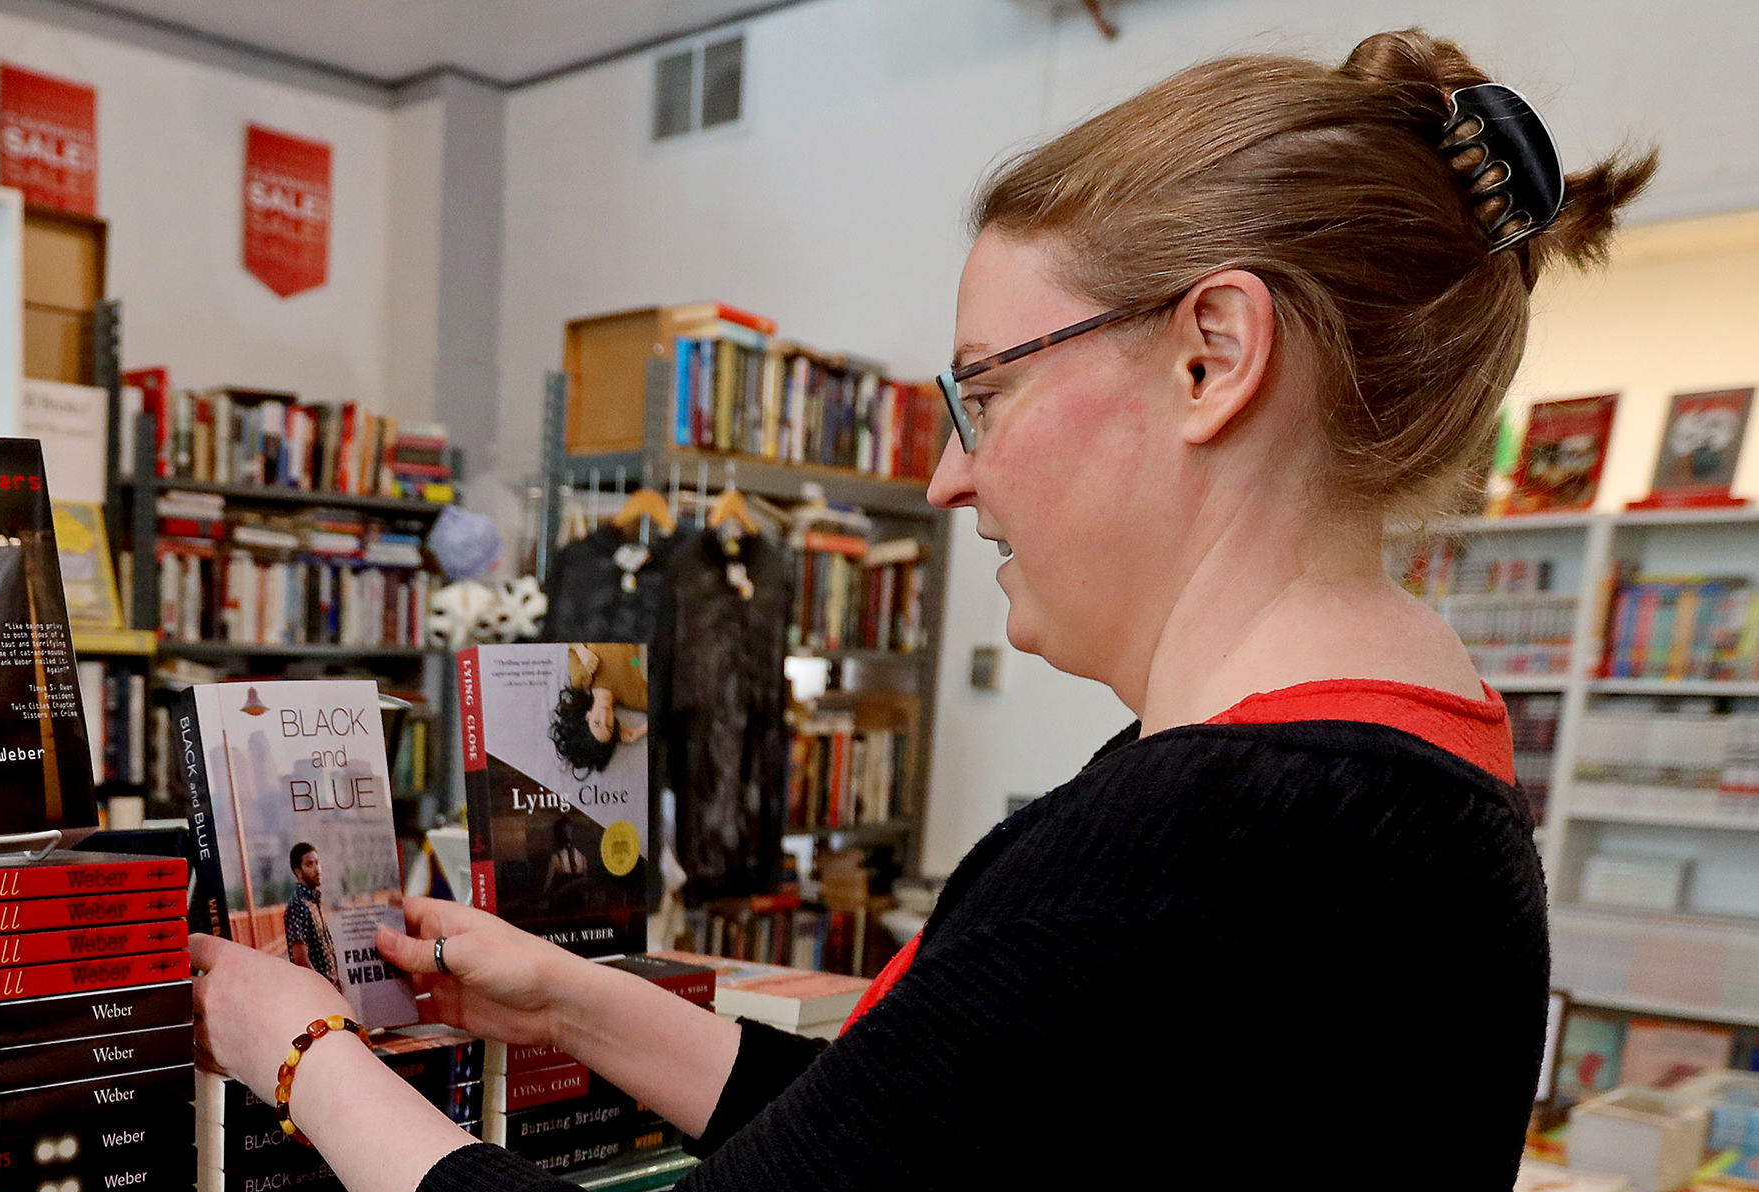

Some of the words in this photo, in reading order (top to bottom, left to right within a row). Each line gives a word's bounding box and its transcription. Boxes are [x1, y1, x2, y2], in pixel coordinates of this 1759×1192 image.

[28, 702, 50, 710] Cities
[52, 701, 76, 709] Chapter
[43, 692, 75, 700] President
[280, 707, 370, 738] BLACK
[311, 745, 347, 769] and
[289, 777, 376, 813] BLUE
[512, 786, 571, 814] Lying
[578, 785, 629, 806] Close
[66, 867, 130, 889] Weber
[92, 1003, 134, 1020] Weber
[521, 1112, 570, 1138] Burning
[575, 1104, 621, 1128] Bridges
[102, 1129, 145, 1148] Weber
